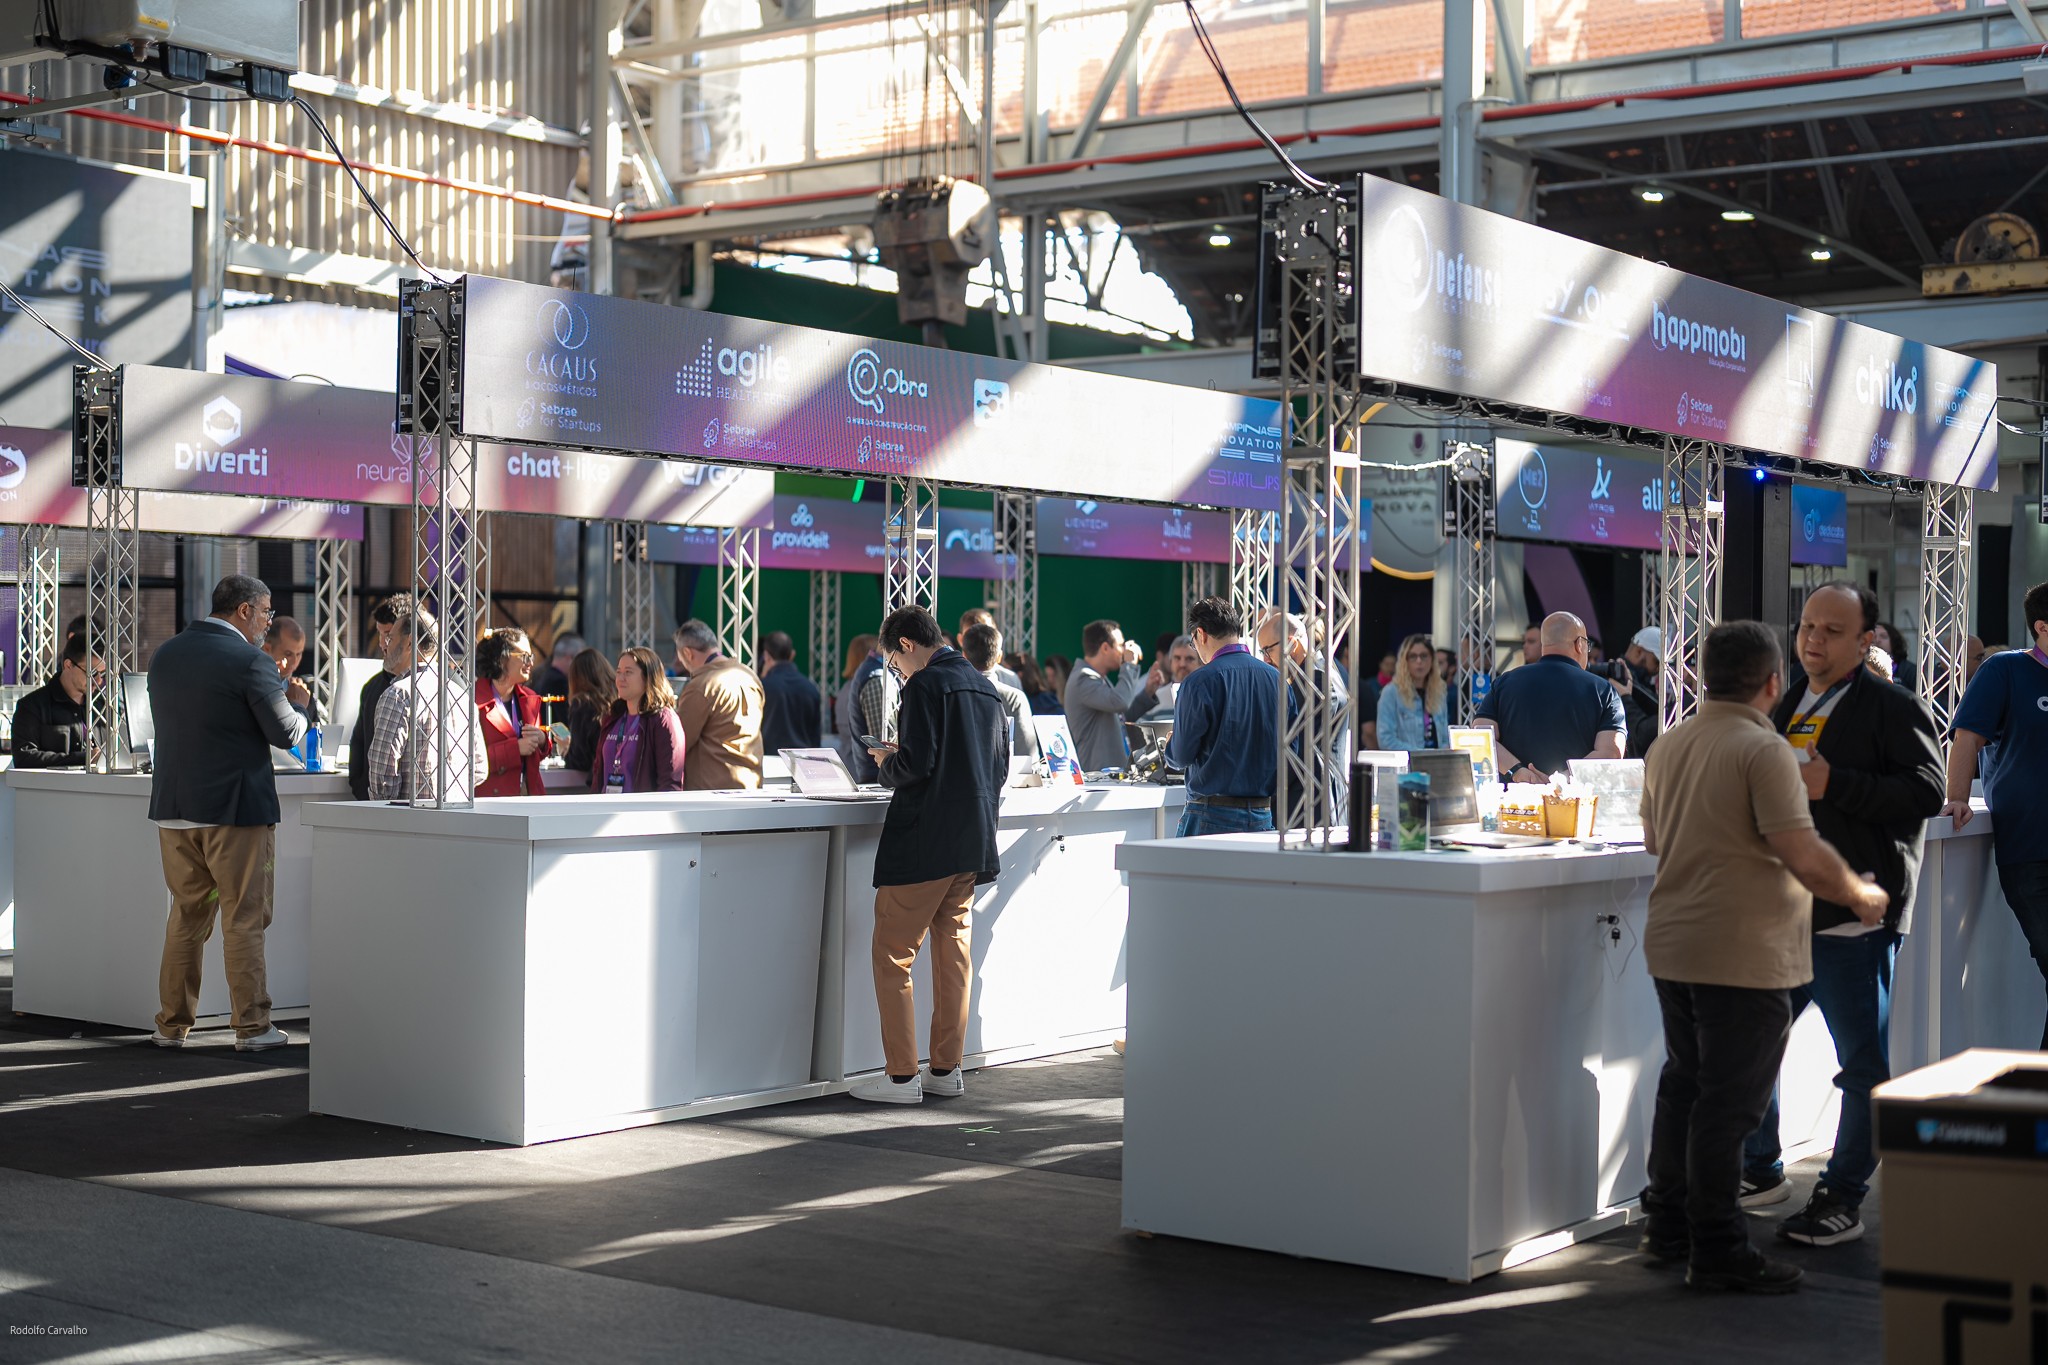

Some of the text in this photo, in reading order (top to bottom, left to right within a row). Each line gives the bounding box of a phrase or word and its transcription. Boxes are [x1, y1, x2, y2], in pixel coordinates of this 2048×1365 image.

[1653, 301, 1746, 361] happmobi
[526, 350, 598, 382] CACAUS
[717, 344, 791, 388] agile
[540, 402, 578, 417] Sebrae
[1690, 397, 1713, 413] Sebrae
[557, 416, 602, 434] Startups
[1222, 421, 1282, 438] AMPINAS
[1701, 413, 1727, 431] Startups
[875, 440, 905, 452] Sebrae
[174, 443, 268, 477] Diverti
[1207, 468, 1280, 492] STARTUPS
